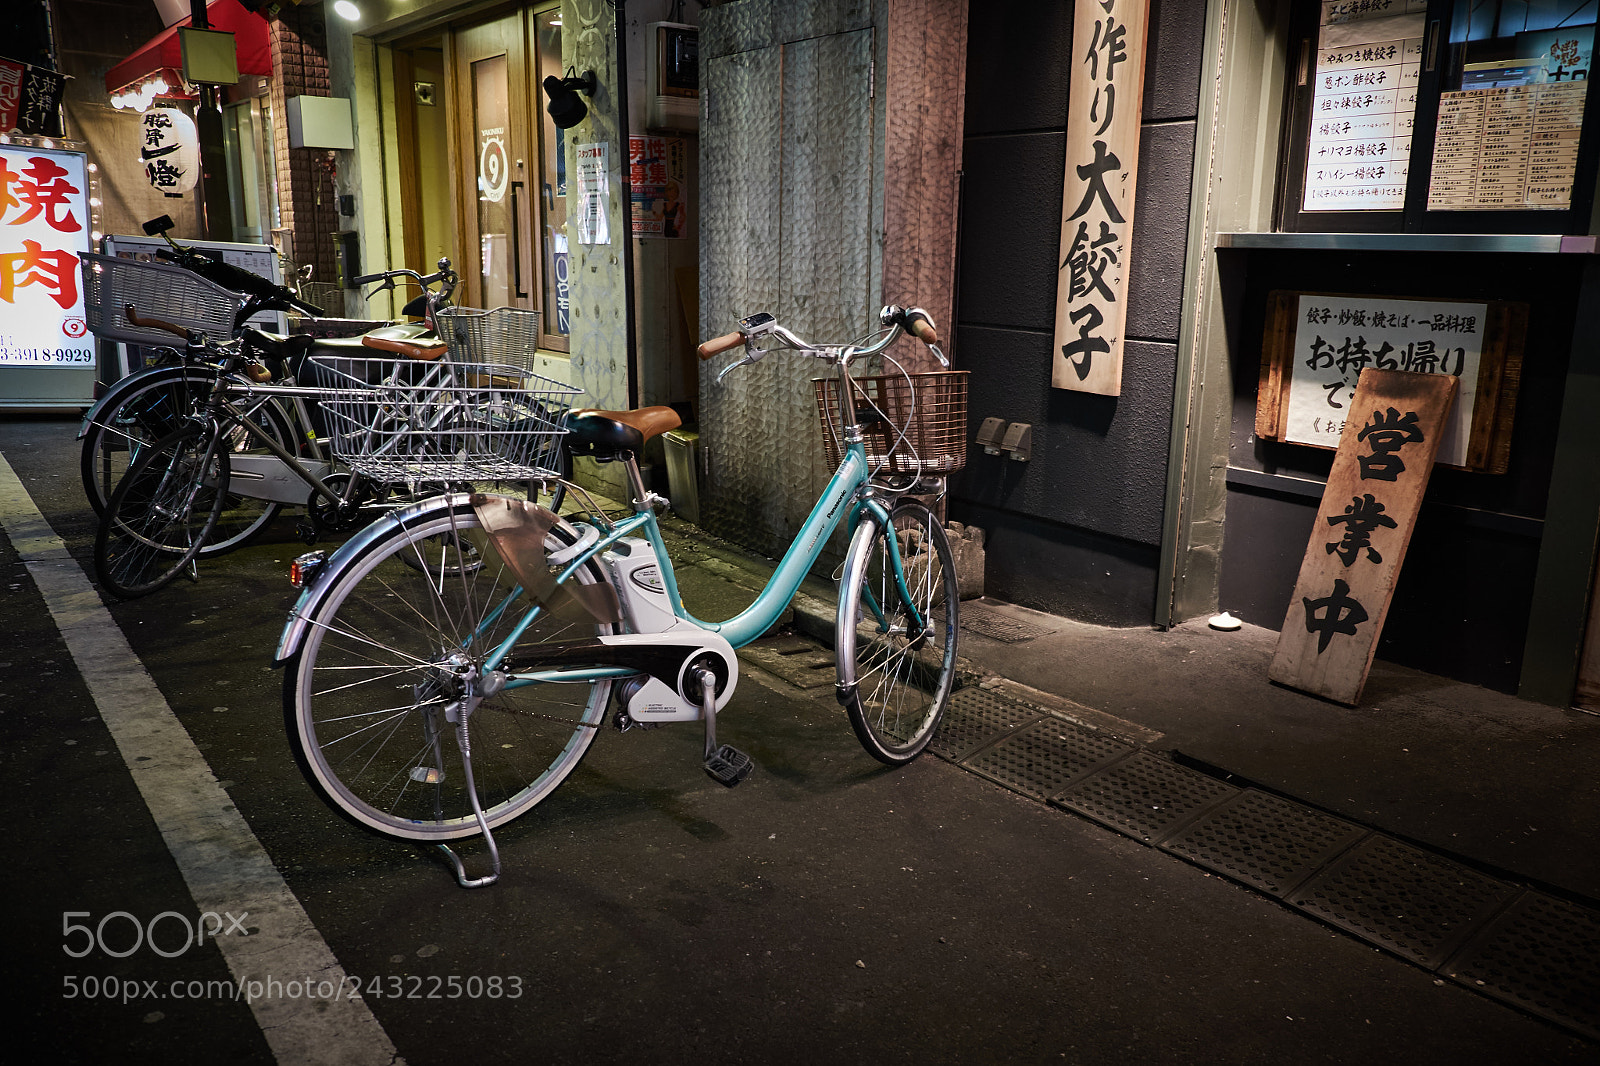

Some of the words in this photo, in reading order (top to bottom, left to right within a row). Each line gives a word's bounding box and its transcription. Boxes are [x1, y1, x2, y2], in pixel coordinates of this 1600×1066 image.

[1327, 45, 1397, 64] やみつき焼餃子
[1318, 142, 1388, 156] チリマヨ揚餃子
[1061, 0, 1127, 381] 作り大餃子
[0, 156, 83, 310] 焼肉
[1305, 335, 1466, 376] お持ち帰り
[826, 489, 847, 519] Panasonic
[1302, 406, 1425, 655] 営業中
